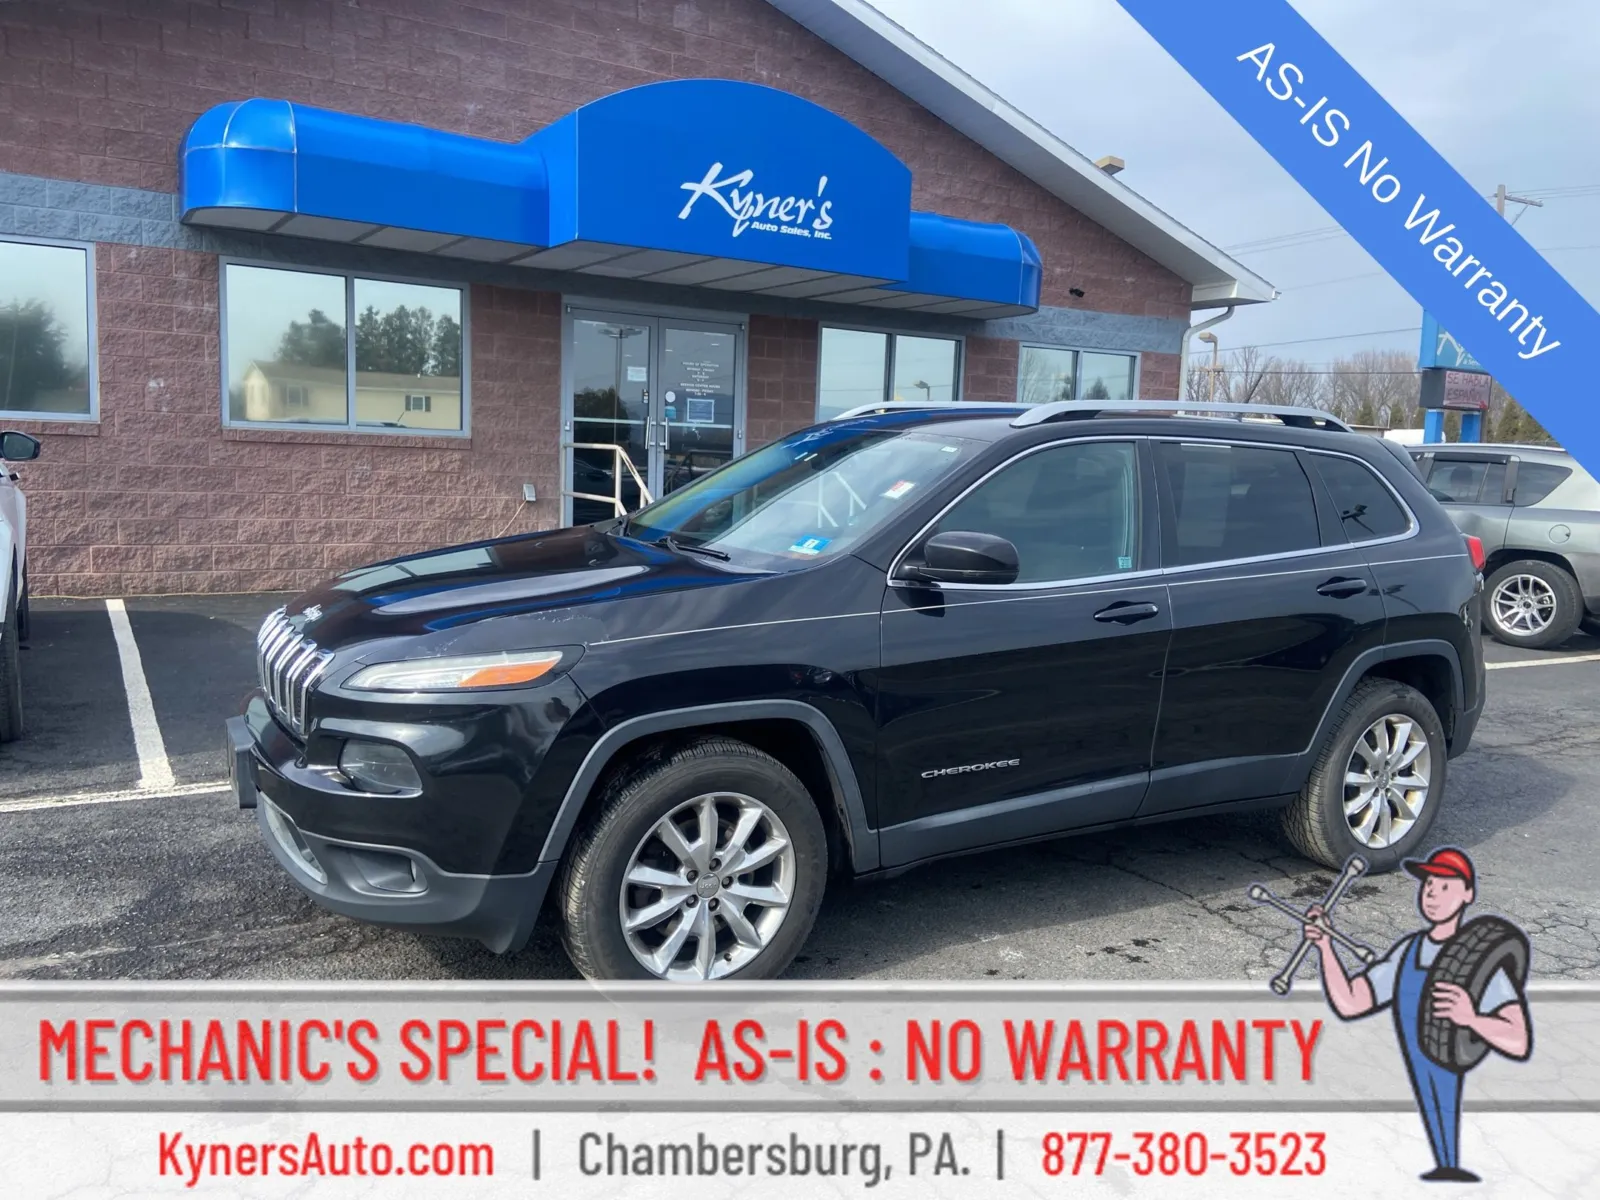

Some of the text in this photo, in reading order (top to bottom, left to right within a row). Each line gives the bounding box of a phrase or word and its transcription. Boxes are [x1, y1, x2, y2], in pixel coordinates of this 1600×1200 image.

[678, 162, 833, 237] Kyner's
[751, 221, 832, 240] Auto Sales, Inc.
[921, 759, 1020, 779] CHEROKEE
